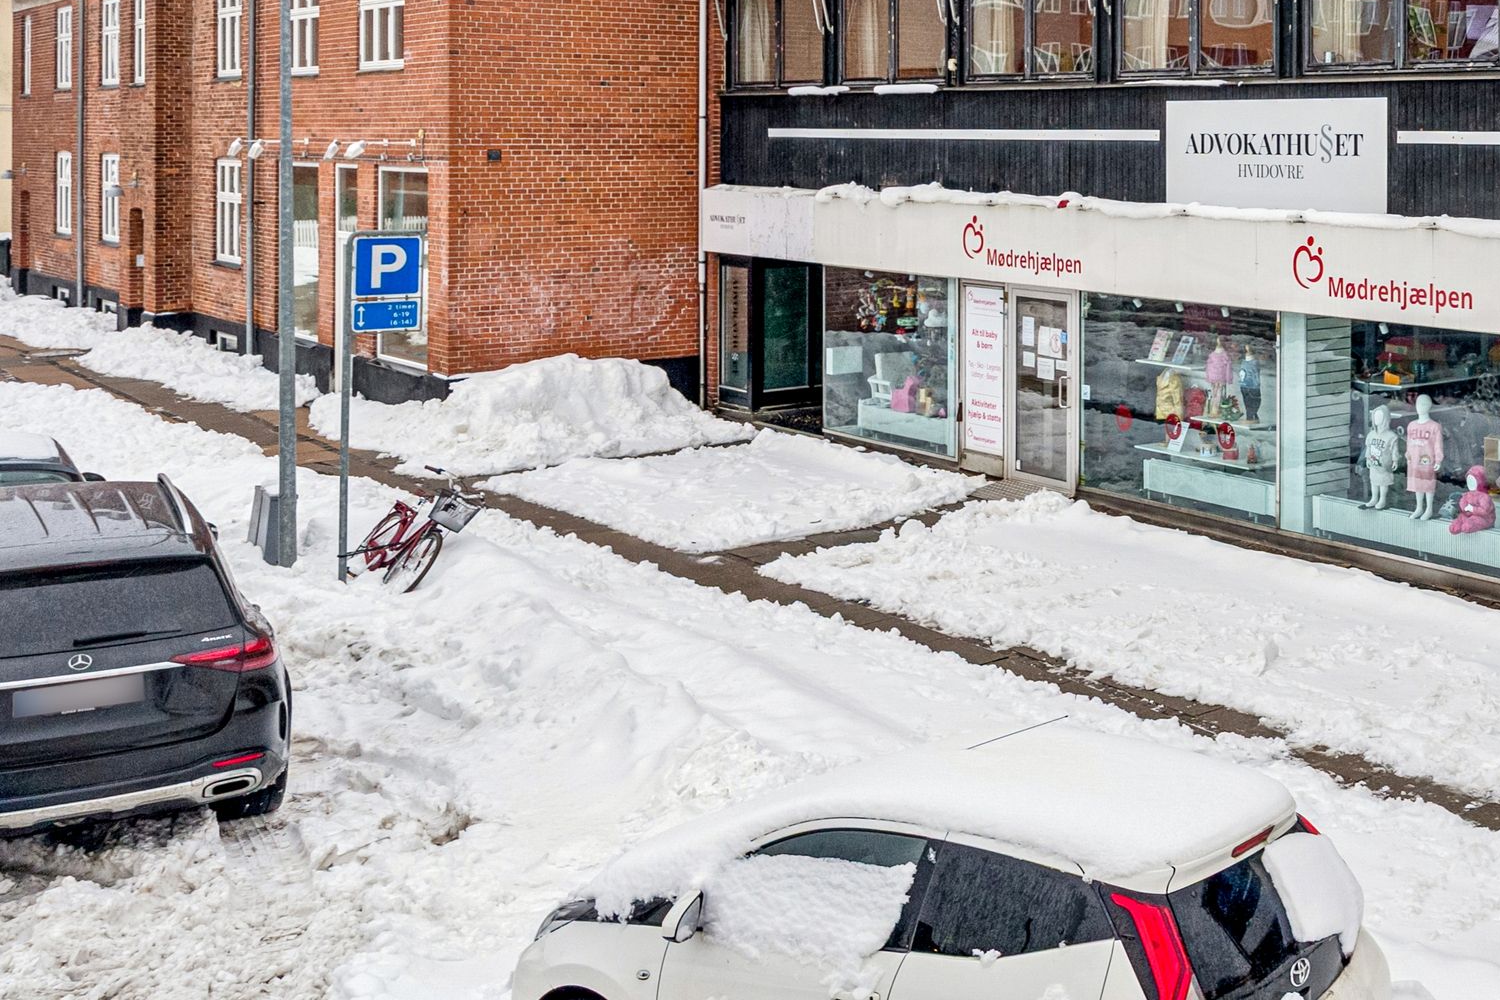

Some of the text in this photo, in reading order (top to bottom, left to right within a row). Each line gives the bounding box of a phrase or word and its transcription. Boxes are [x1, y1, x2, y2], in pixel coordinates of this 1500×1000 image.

[1238, 163, 1304, 179] HVIDOVRE
[371, 245, 407, 288] P
[986, 248, 1082, 278] Mødrehjælpen
[1328, 276, 1473, 313] Mødrehjælpen
